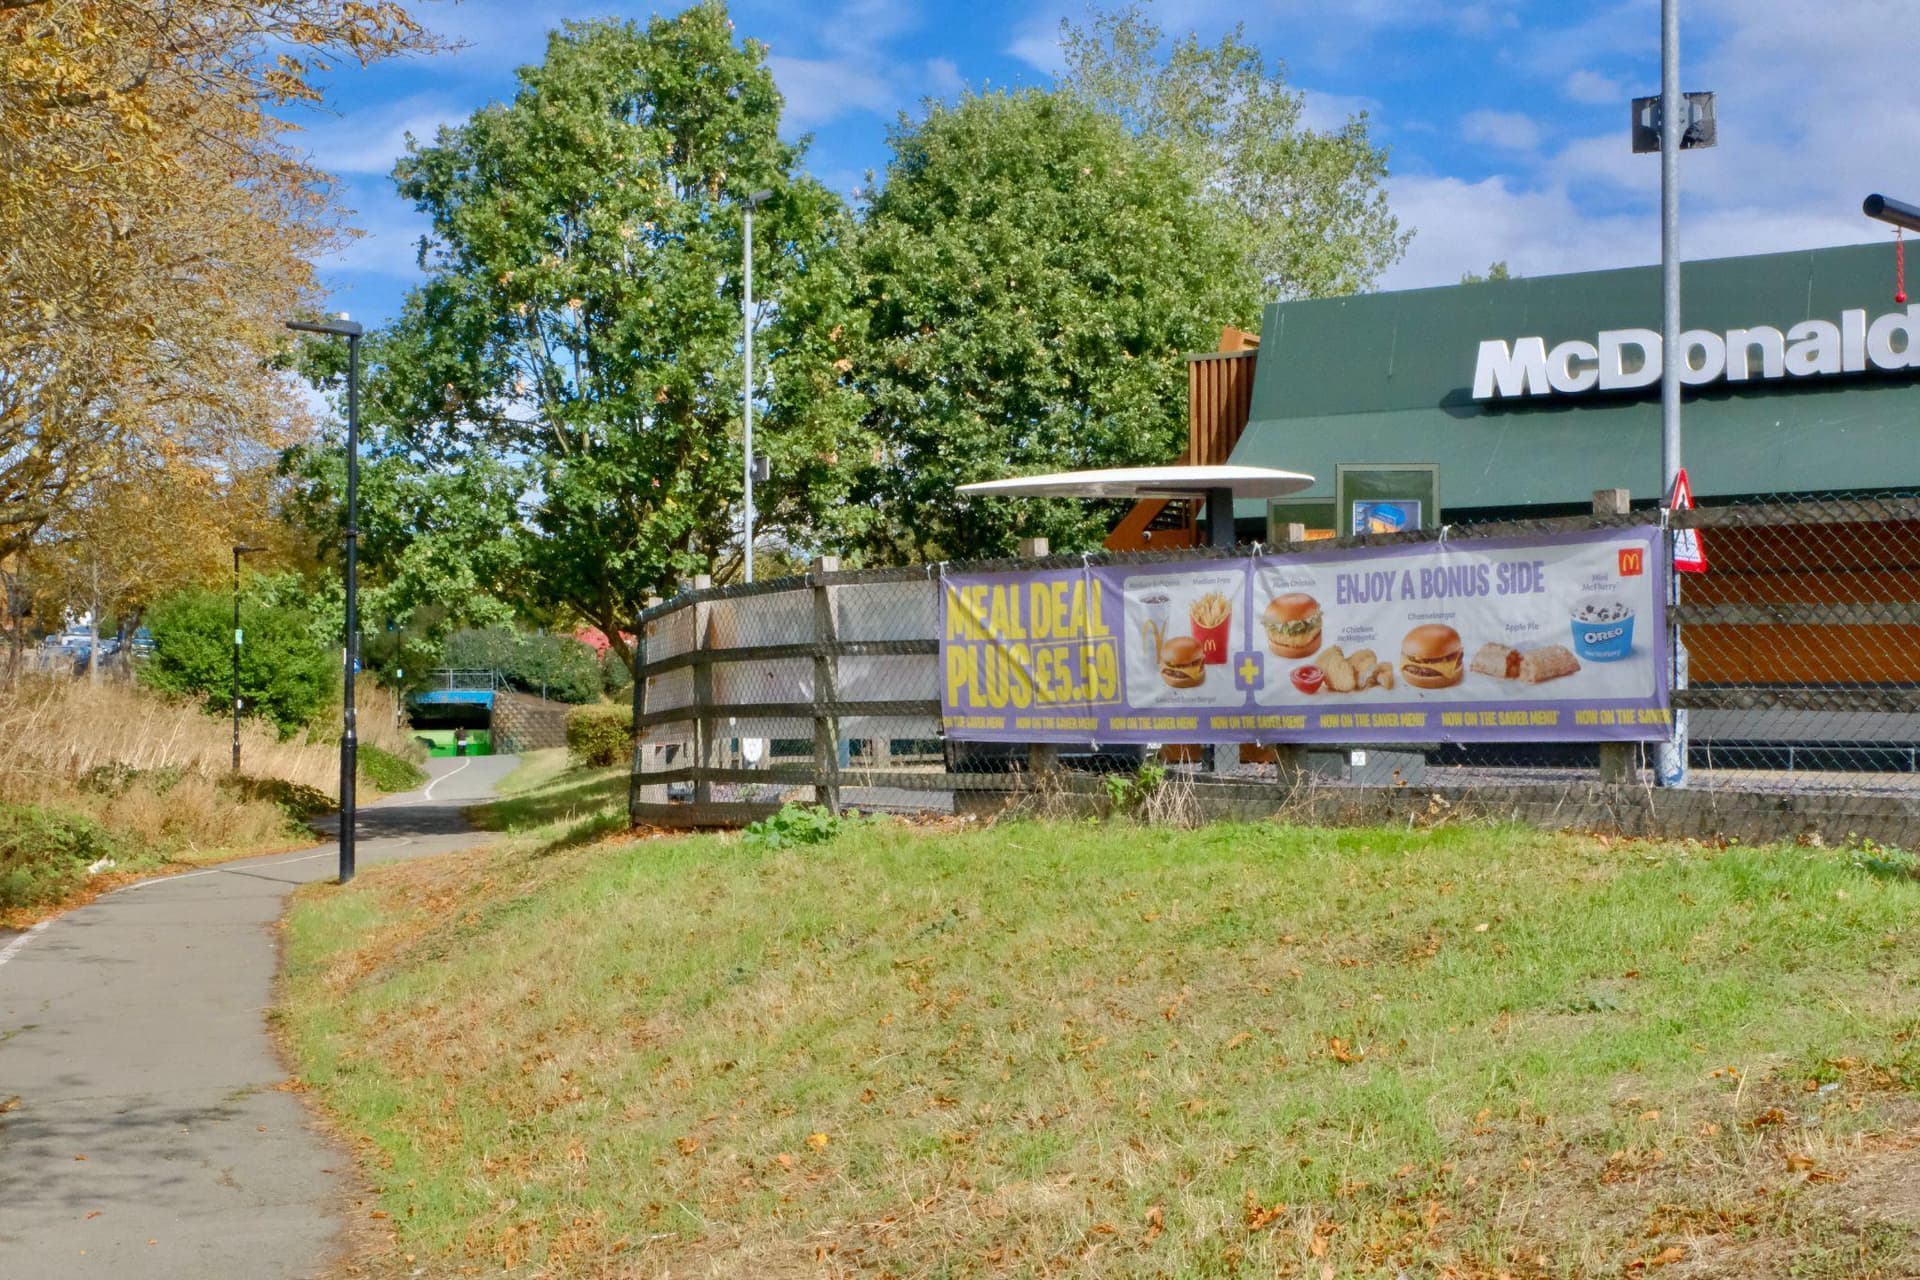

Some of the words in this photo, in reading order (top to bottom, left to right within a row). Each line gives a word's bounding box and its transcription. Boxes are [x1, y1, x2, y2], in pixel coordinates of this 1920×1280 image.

[1336, 570, 1397, 605] ENJOY
[1401, 570, 1416, 601] A
[1420, 563, 1490, 600] BONUS
[1496, 560, 1545, 596] SIDE
[946, 583, 1027, 641] MEAL
[1030, 578, 1110, 640] DEAL
[1505, 622, 1526, 632] Apple
[1584, 627, 1624, 645] OREO
[946, 642, 1033, 709] PLUS
[1035, 642, 1117, 703] £5.59
[1320, 714, 1339, 728] NOW
[1340, 714, 1352, 728] ON
[1354, 713, 1370, 727] THE
[1372, 713, 1399, 727] SAVER
[1441, 712, 1462, 726] NOW
[1464, 712, 1478, 726] ON
[1479, 711, 1497, 726] THE
[1498, 711, 1528, 726] SAVER
[1575, 710, 1598, 725] NOW
[1600, 710, 1614, 725] ON
[1616, 709, 1636, 724] THE
